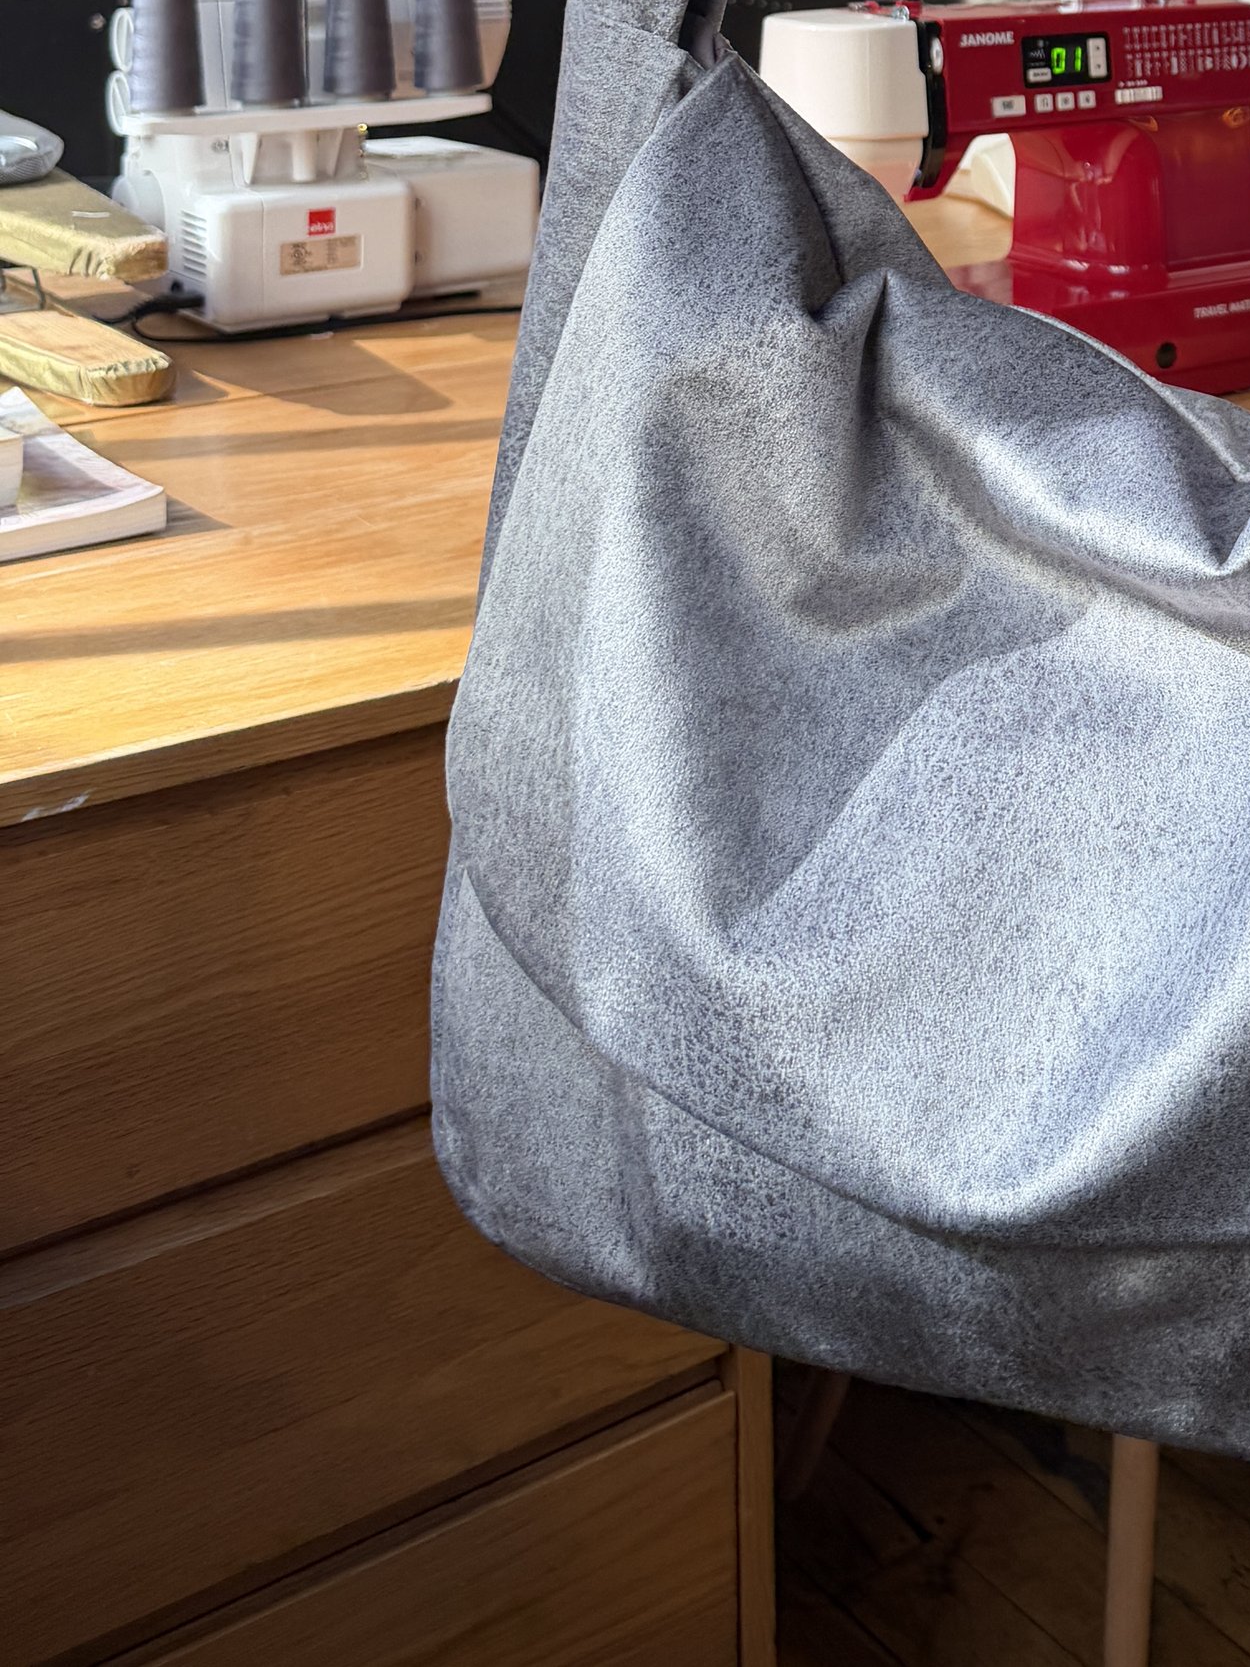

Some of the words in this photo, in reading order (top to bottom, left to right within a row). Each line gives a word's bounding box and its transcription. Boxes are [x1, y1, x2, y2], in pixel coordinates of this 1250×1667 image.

[959, 30, 1015, 48] JANOME
[1051, 45, 1082, 75] 01
[1193, 303, 1229, 319] TRAVEL
